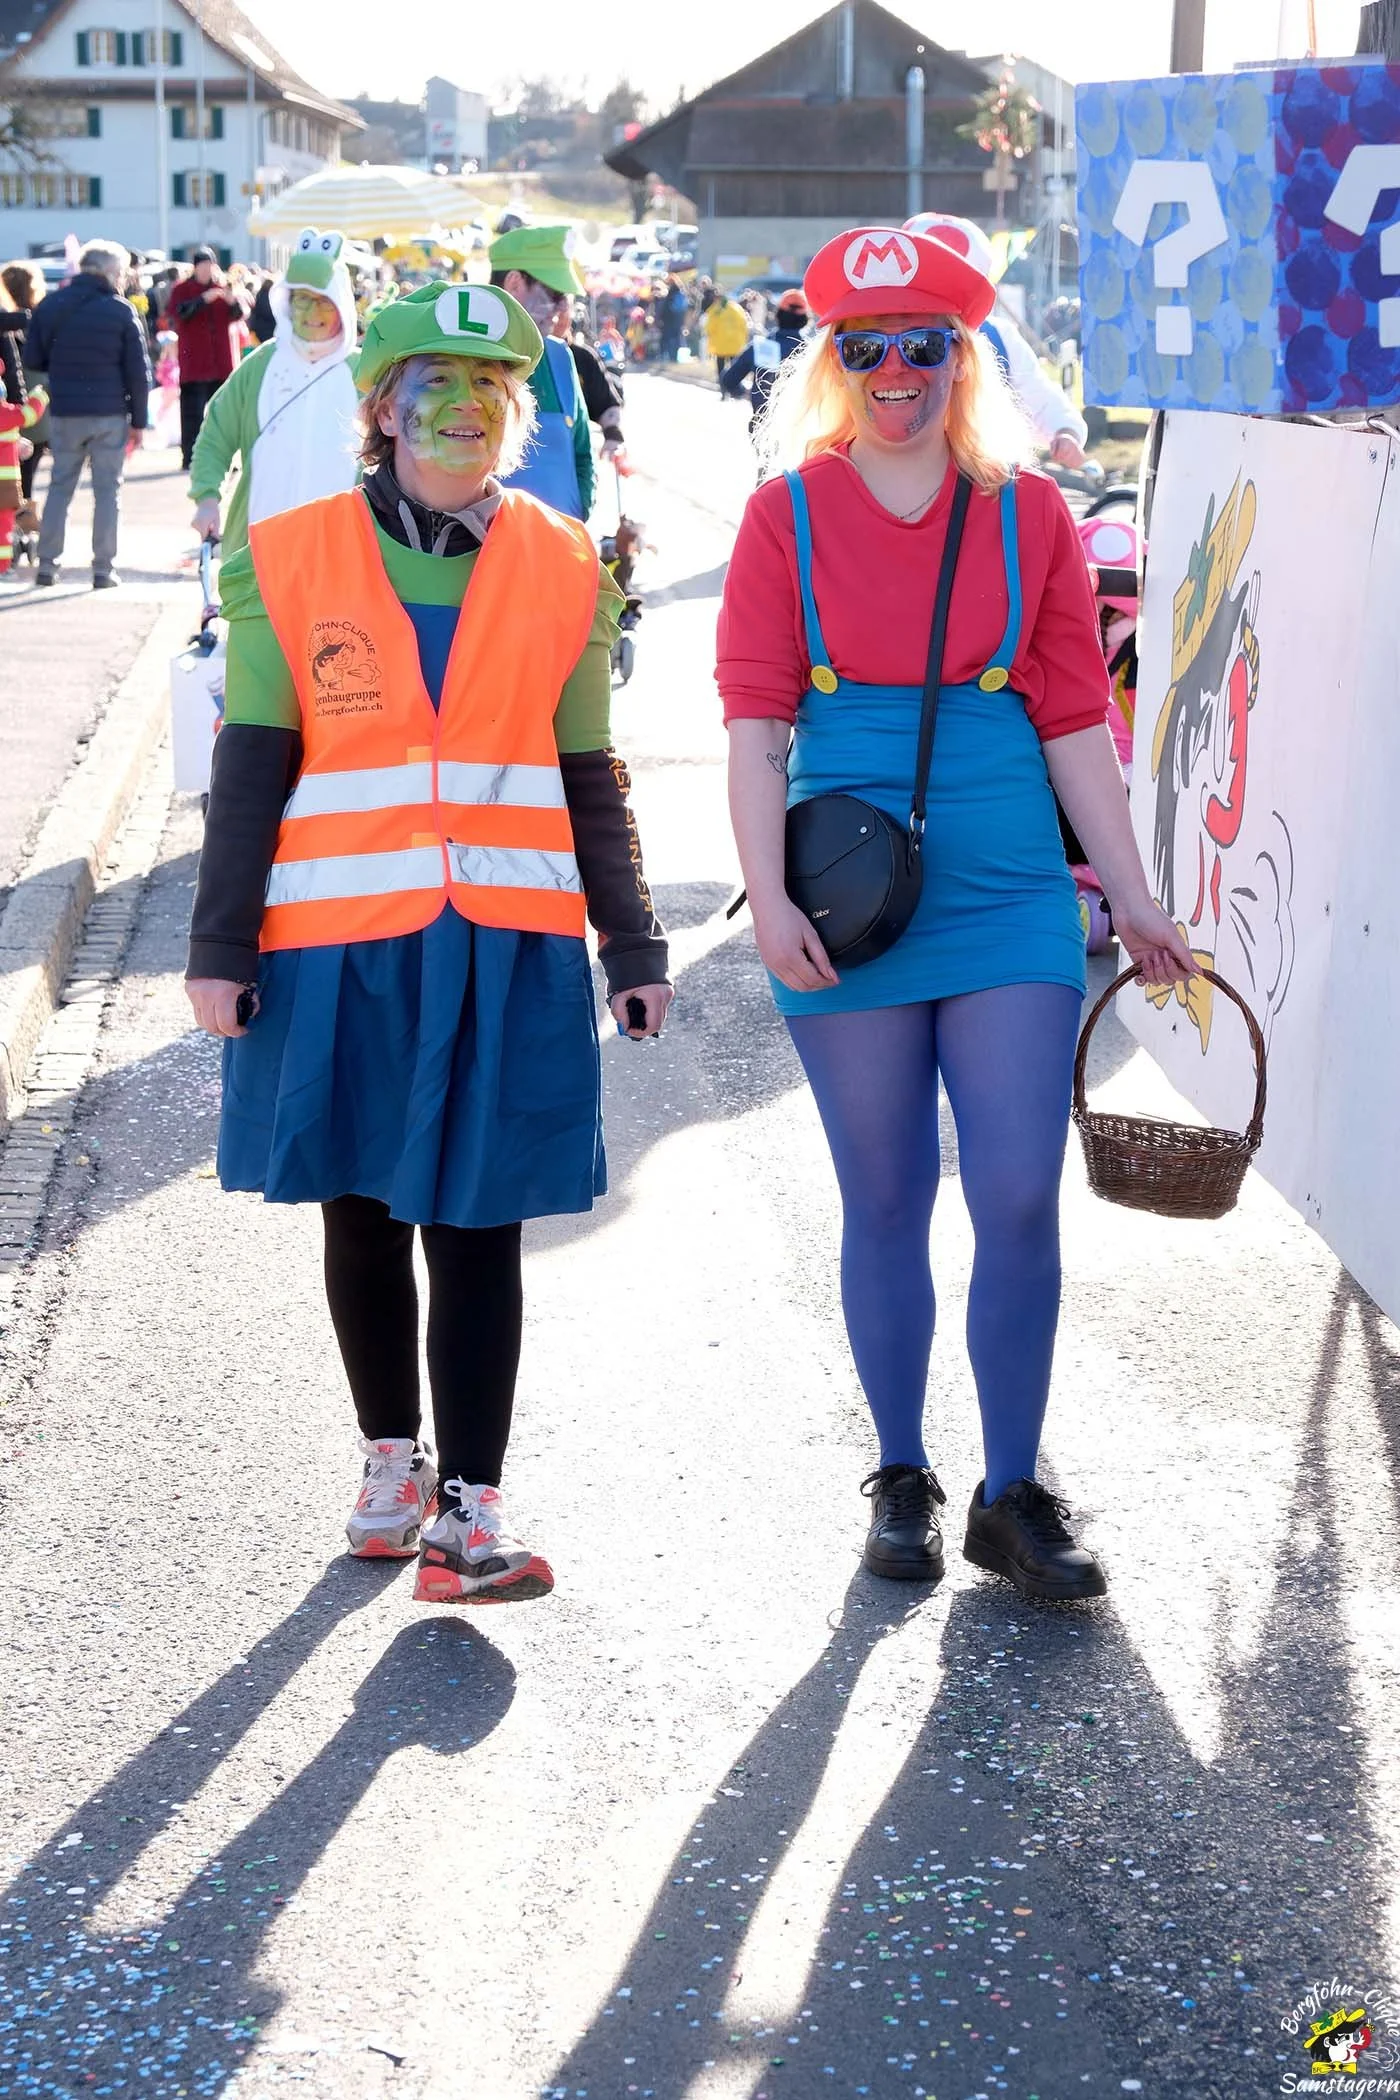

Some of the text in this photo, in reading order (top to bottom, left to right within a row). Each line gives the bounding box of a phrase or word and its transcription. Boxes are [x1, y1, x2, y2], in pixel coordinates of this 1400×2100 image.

[852, 236, 912, 279] M
[1112, 159, 1229, 356] ?
[458, 291, 489, 336] L
